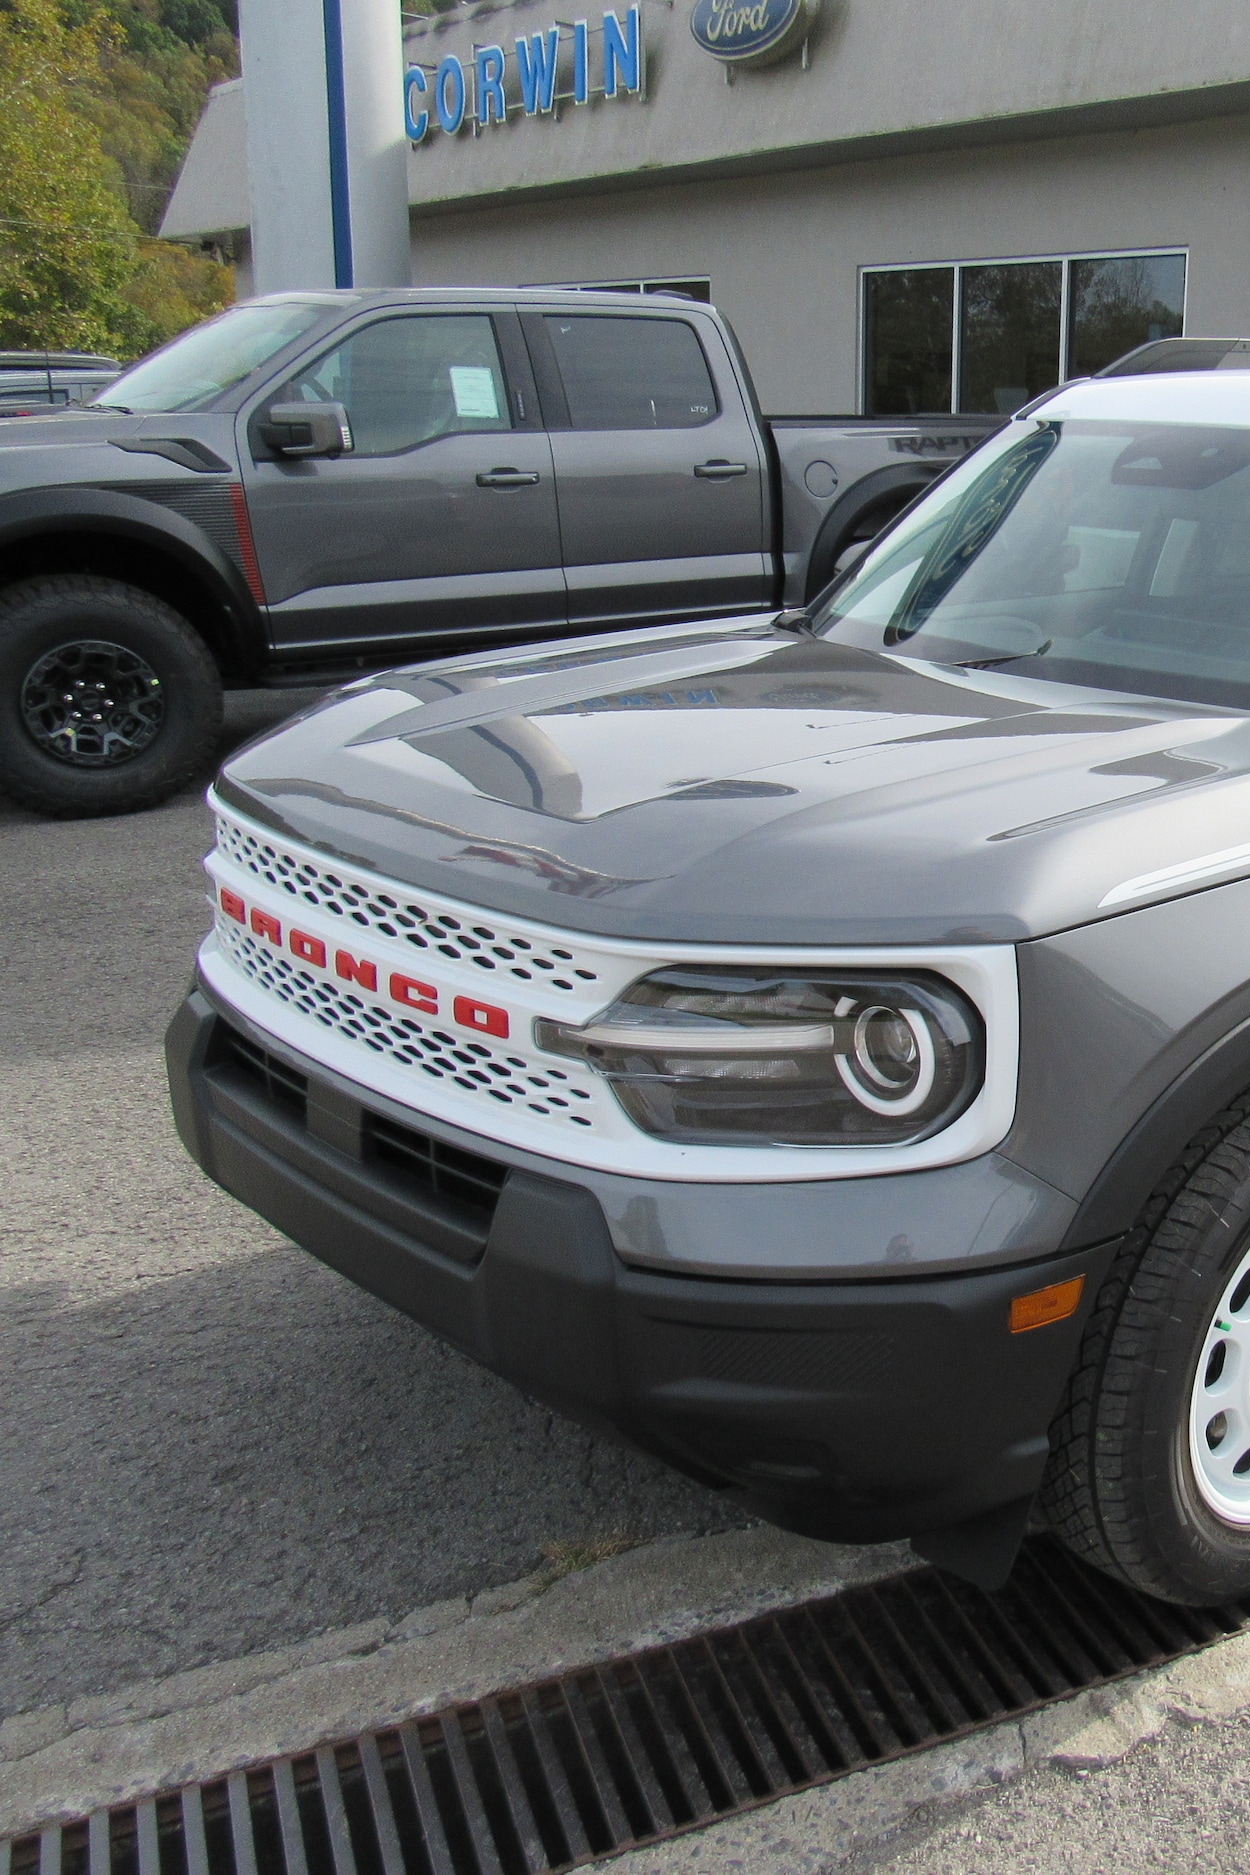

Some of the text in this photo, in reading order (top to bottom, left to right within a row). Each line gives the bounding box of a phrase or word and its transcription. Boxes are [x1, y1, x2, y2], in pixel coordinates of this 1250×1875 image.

[404, 3, 641, 144] CORWIN
[706, 0, 770, 41] Ford
[220, 887, 510, 1040] BRONCO
